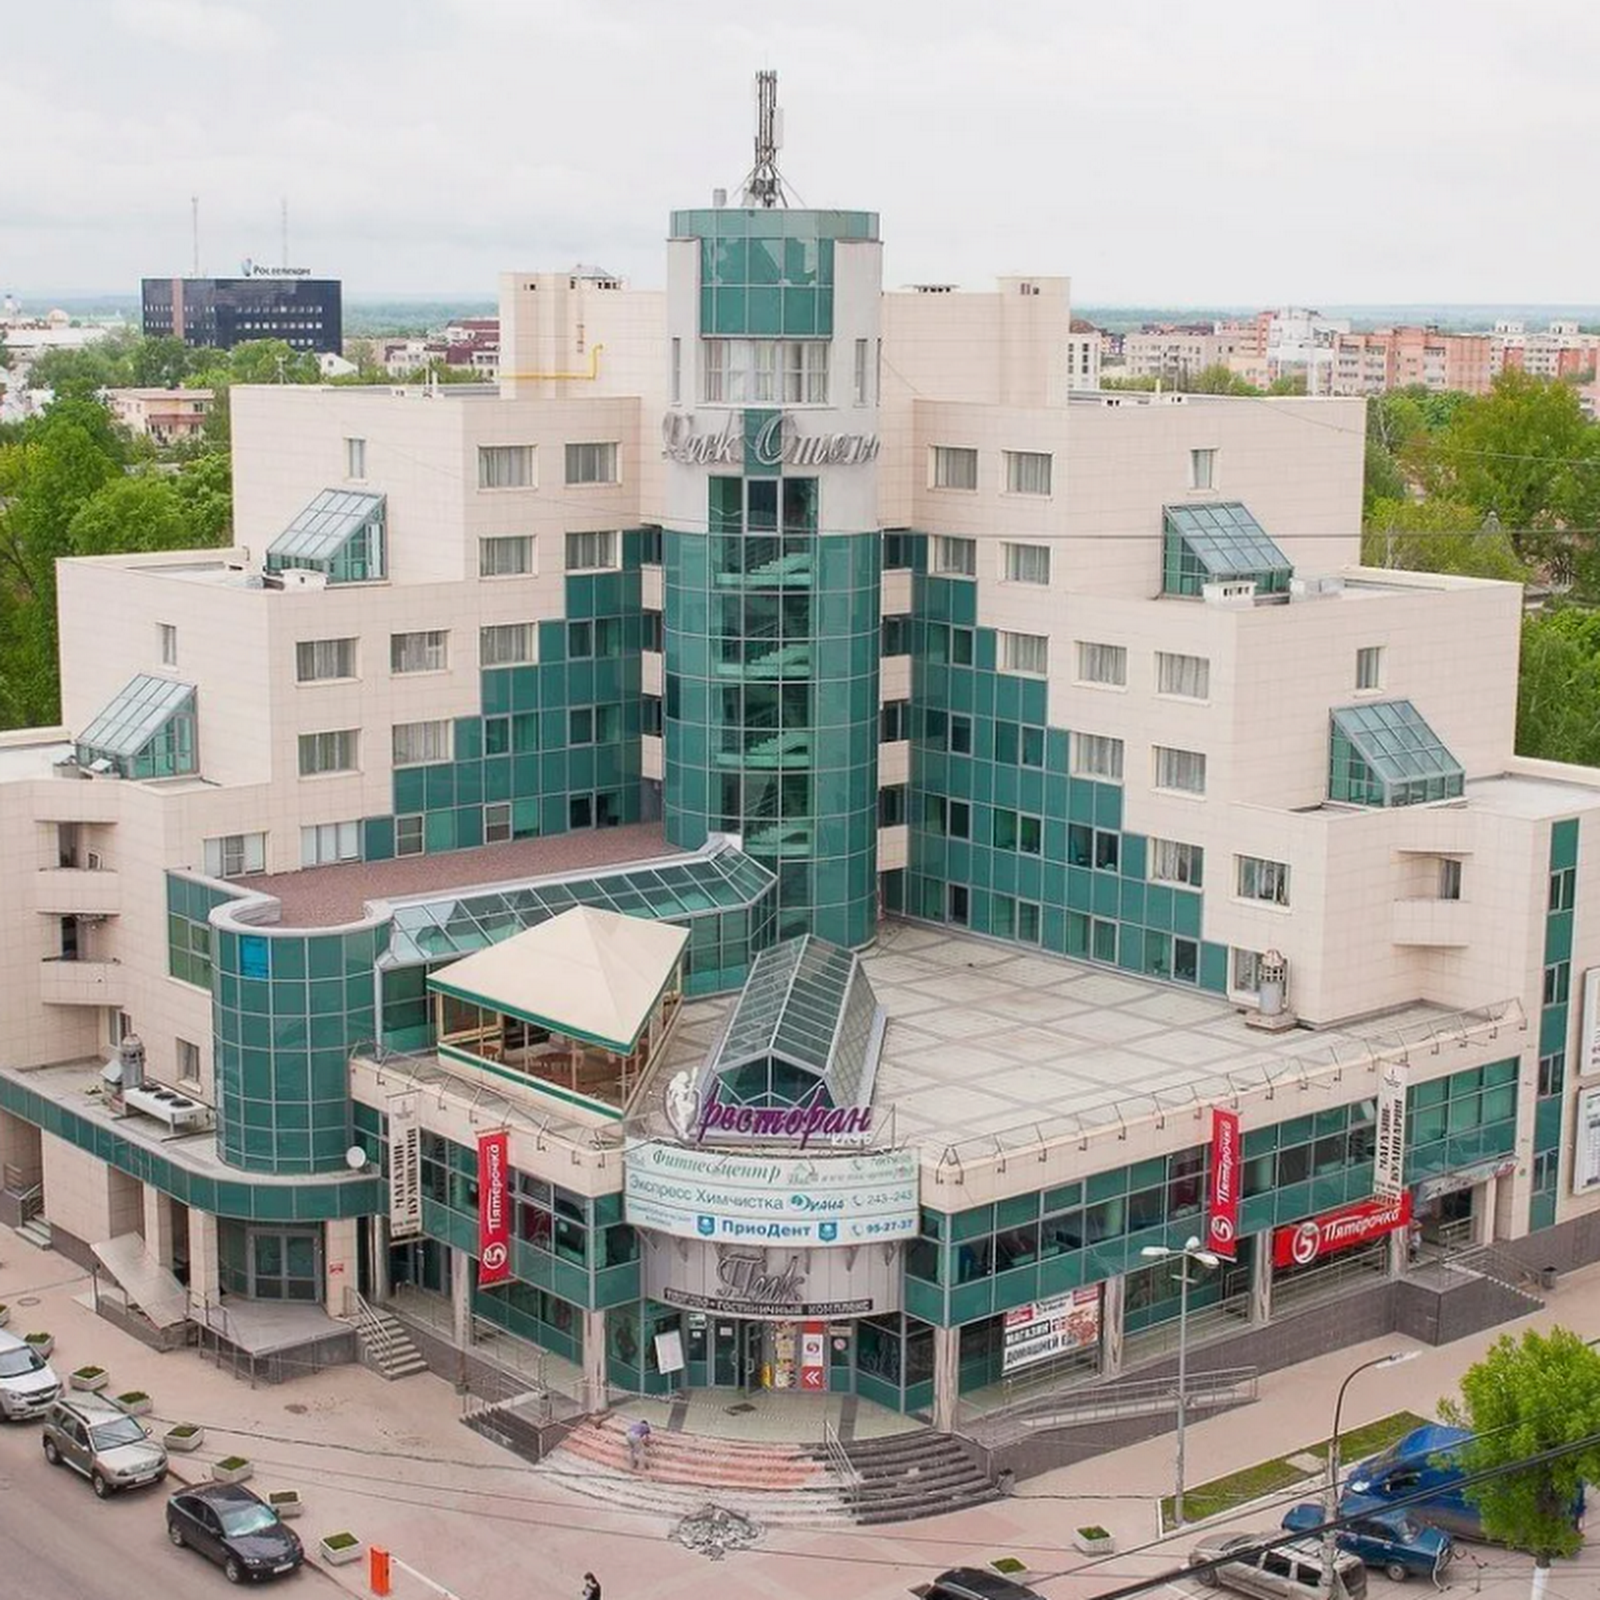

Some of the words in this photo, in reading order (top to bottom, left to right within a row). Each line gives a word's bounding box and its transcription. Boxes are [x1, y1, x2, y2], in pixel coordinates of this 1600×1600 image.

[406, 1127, 418, 1216] КУЛИНАРИЯ
[629, 1173, 692, 1201] Экспресс
[695, 1186, 784, 1211] Химчистка
[721, 1219, 812, 1238] ПриоДент
[1321, 1209, 1400, 1242] Пятерочка
